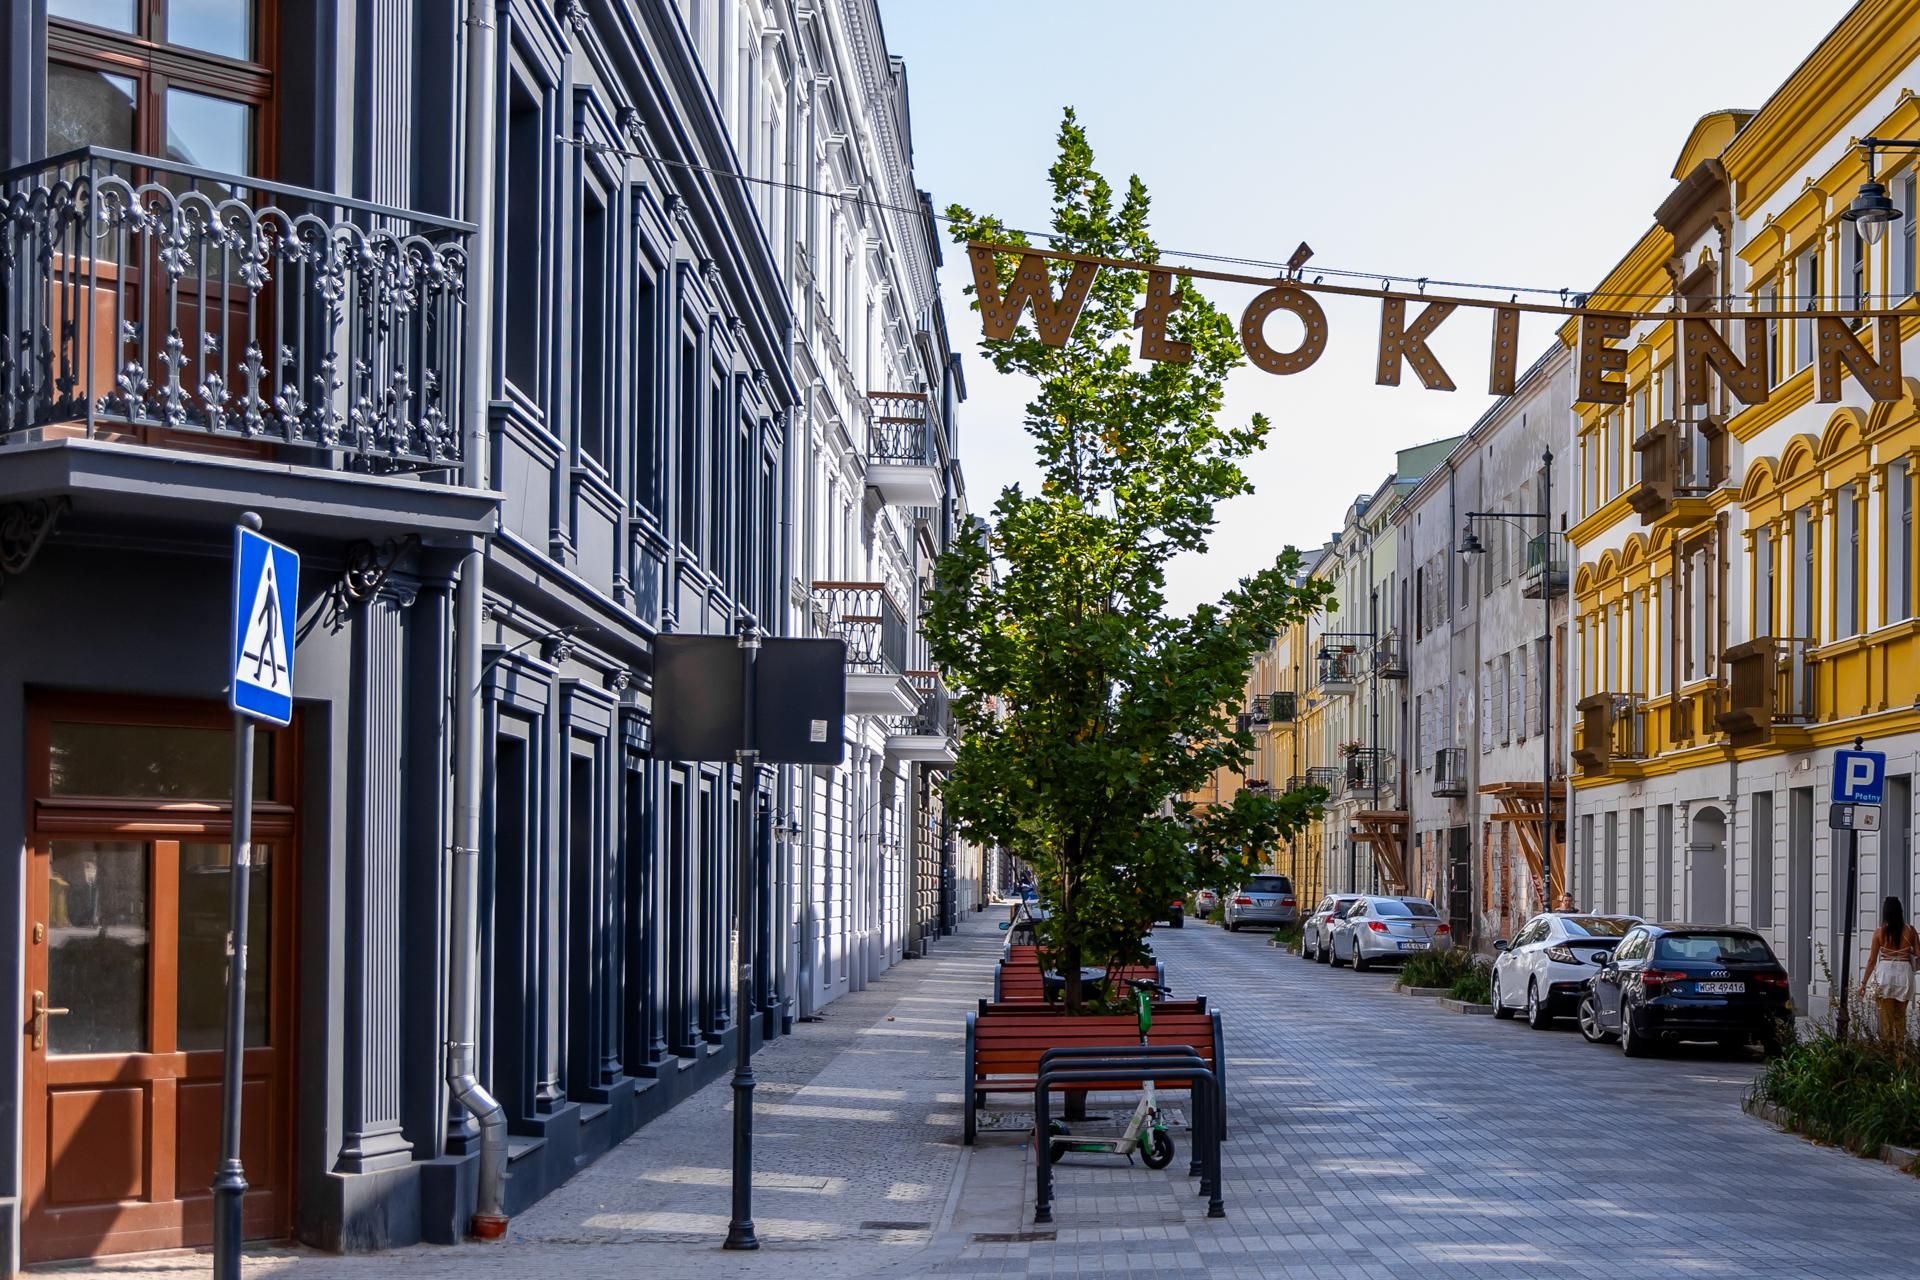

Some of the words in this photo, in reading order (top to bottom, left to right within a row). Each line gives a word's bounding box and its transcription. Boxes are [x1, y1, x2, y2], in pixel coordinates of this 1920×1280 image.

[1844, 757, 1875, 796] P
[1855, 792, 1880, 802] Płatny
[1699, 983, 1716, 992] WGR
[1718, 983, 1744, 992] 49416
